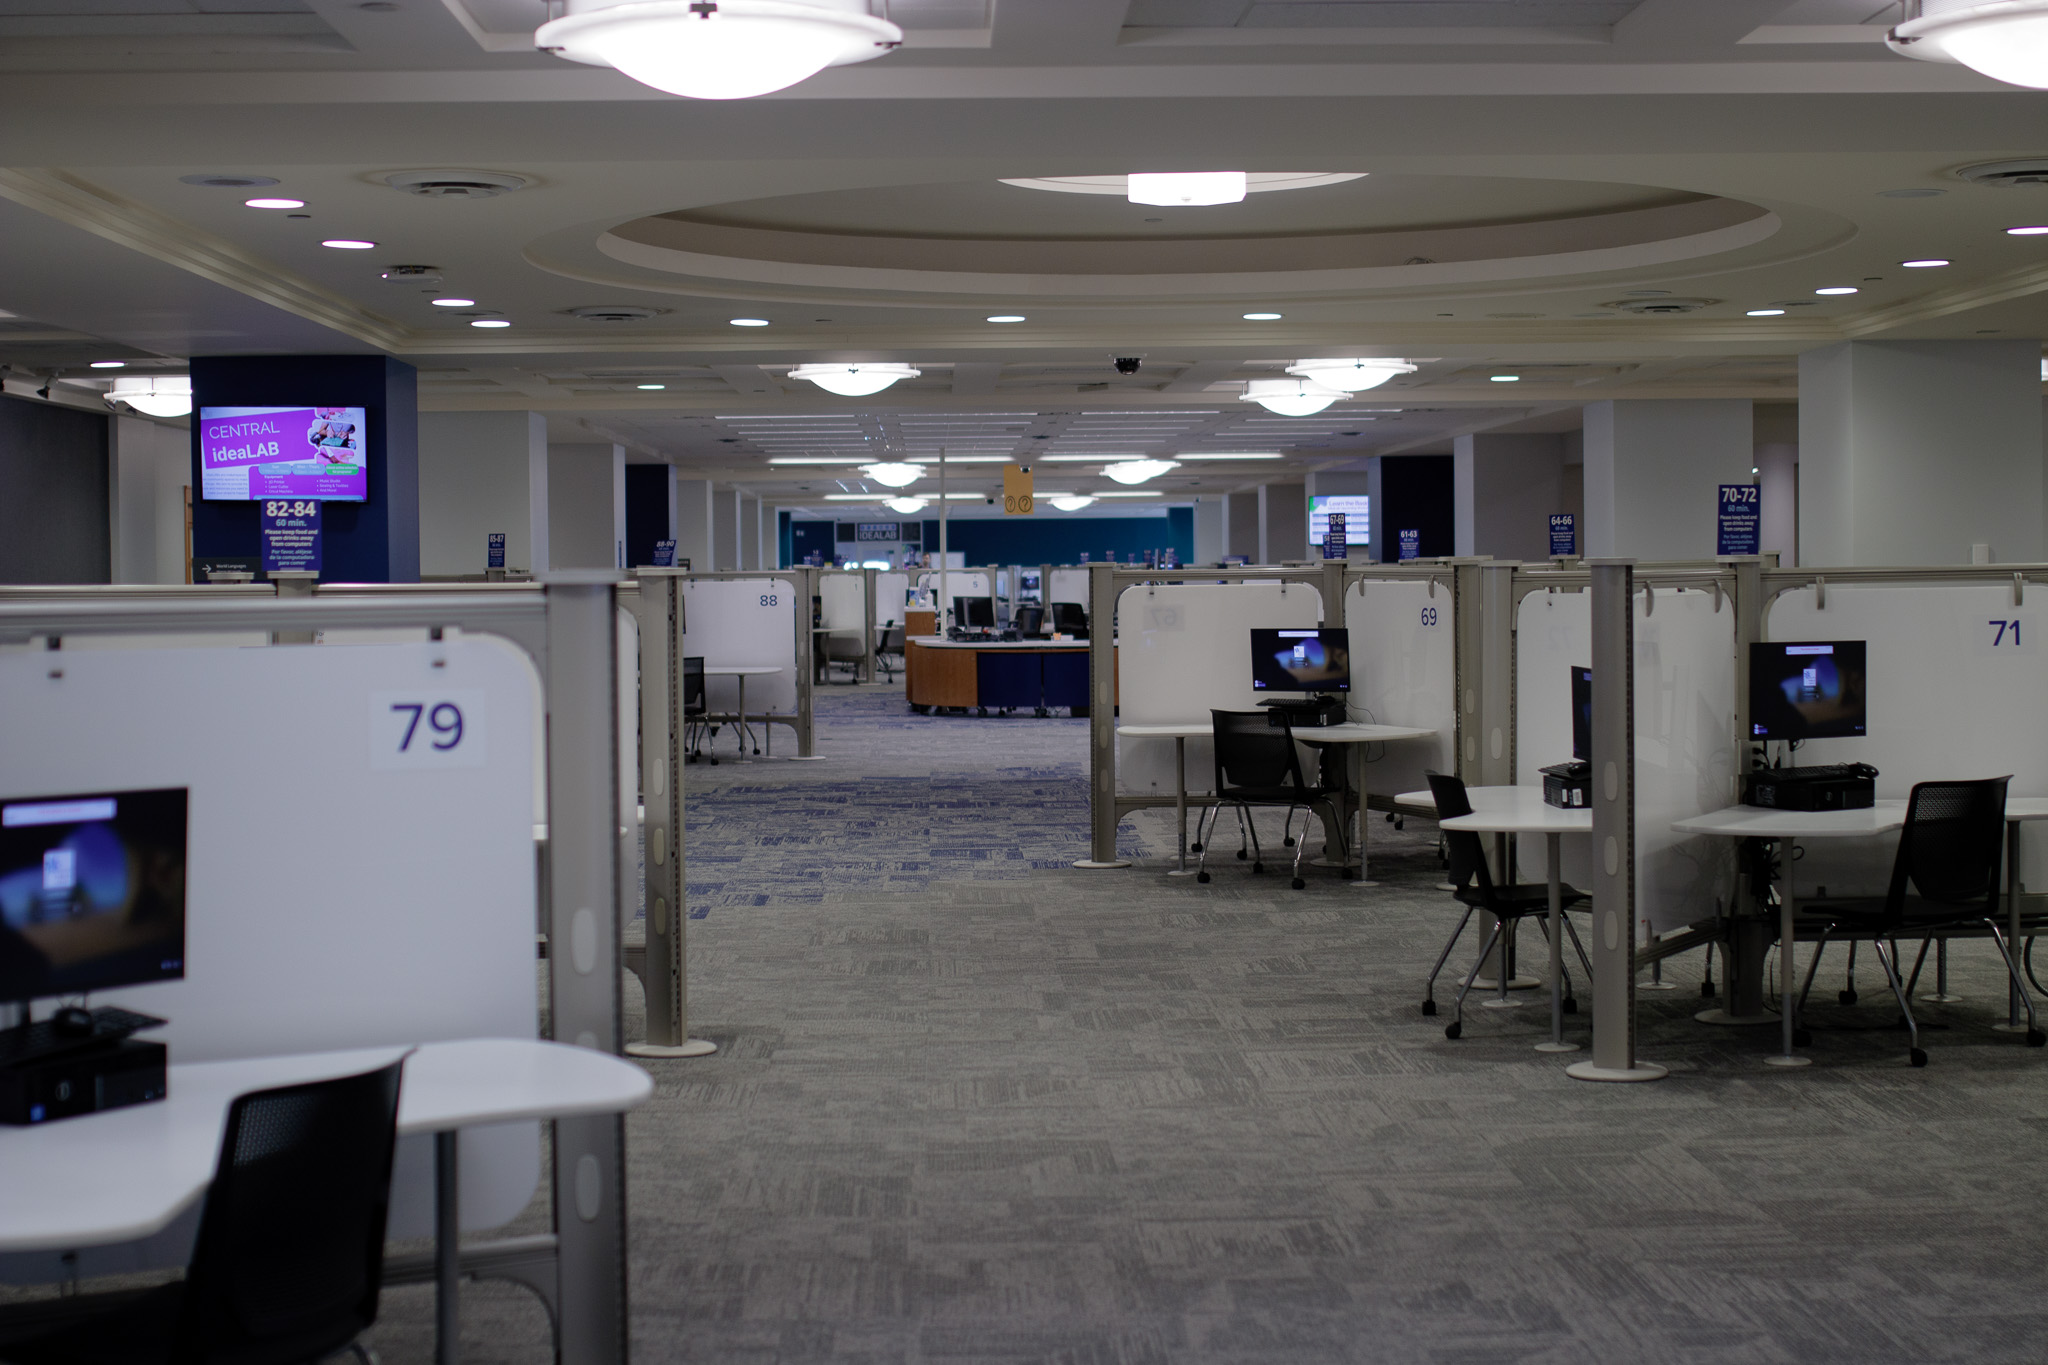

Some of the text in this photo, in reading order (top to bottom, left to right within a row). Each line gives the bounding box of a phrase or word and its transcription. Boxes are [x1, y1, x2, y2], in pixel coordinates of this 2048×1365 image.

[208, 420, 280, 439] CENTRAL
[212, 442, 280, 462] ideaLAB
[1722, 488, 1757, 502] 70-72
[266, 501, 316, 517] 82-84
[1330, 514, 1344, 525] 67-69
[1551, 516, 1572, 525] 64-66
[860, 531, 896, 540] IDEALAB
[760, 595, 777, 607] 88
[1421, 607, 1437, 626] 69
[1989, 620, 2020, 646] 71
[390, 702, 464, 752] 79
